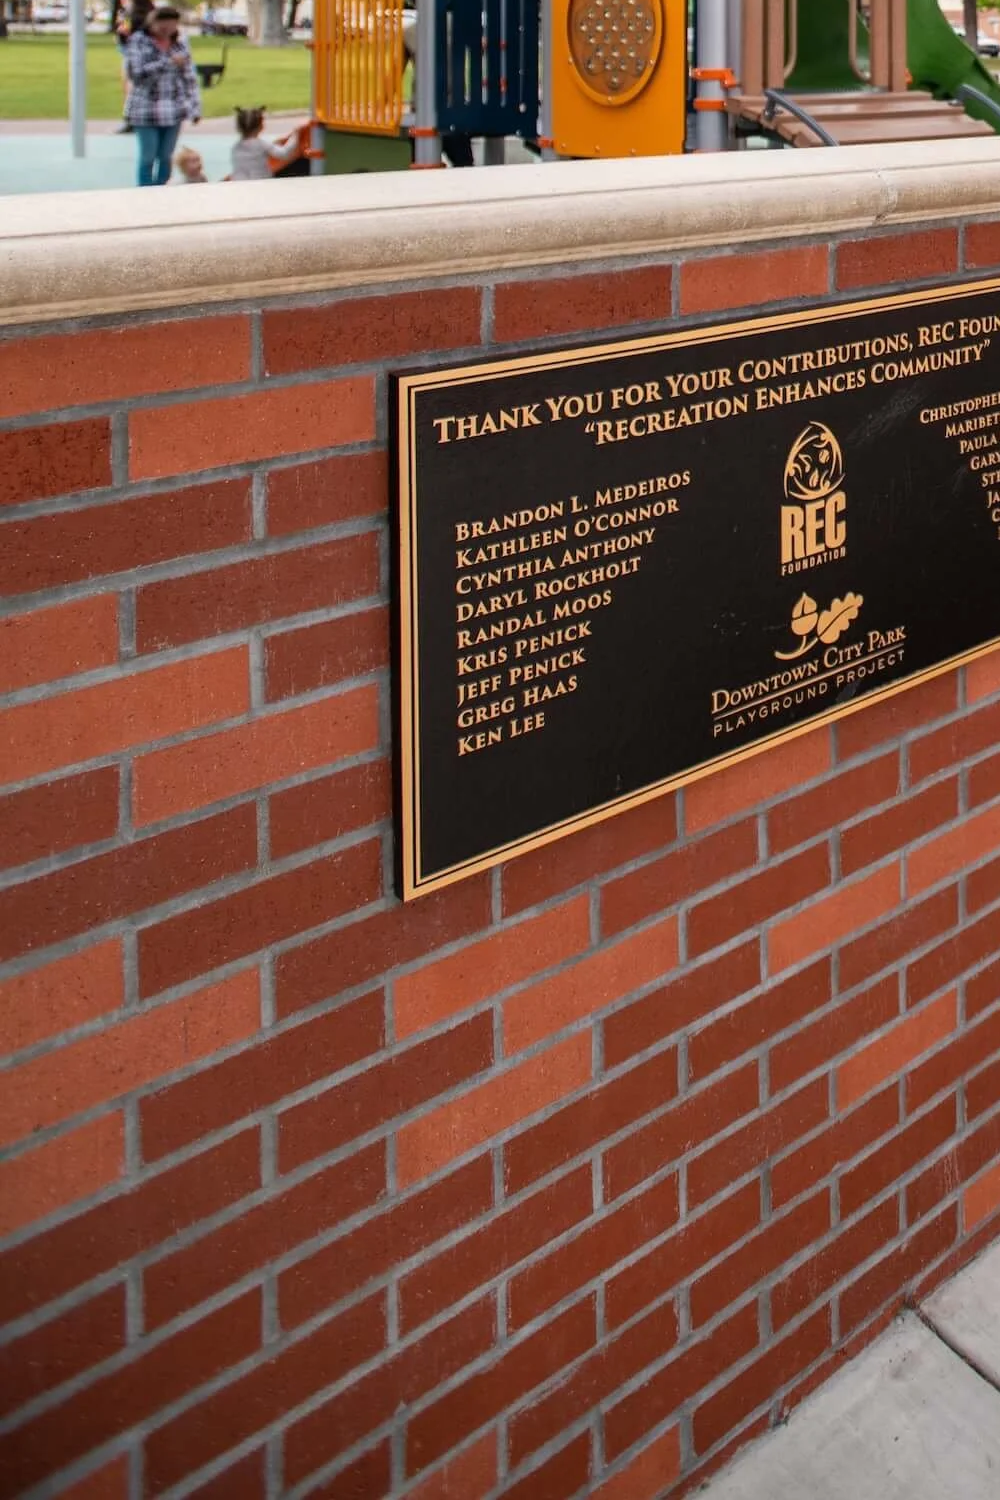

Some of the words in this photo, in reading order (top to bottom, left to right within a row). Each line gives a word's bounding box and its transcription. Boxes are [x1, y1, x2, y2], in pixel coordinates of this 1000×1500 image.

[432, 403, 542, 444] THANK
[544, 391, 604, 422] YOU
[610, 381, 663, 410] FOR
[665, 367, 734, 398] YOUR
[737, 332, 914, 383] CONTRIBUTIONS,
[917, 321, 955, 348] REC
[755, 368, 866, 410] ENHANCES
[959, 433, 998, 454] PAULA
[455, 501, 564, 542] BRANDON
[570, 495, 589, 514] L.
[594, 470, 691, 508] MEDEIROS
[780, 491, 847, 563] REC
[455, 525, 567, 569] KATHLEEN
[455, 556, 556, 595] CYNTHIA
[559, 527, 656, 568] ANTHONY
[781, 547, 846, 577] FOUNDATION
[456, 589, 528, 623] DARYL
[534, 556, 641, 601] ROCKHOLT
[457, 610, 547, 650] RANDAL
[552, 589, 612, 621] MOOS
[456, 646, 508, 676] KRIS
[515, 620, 592, 658] PENICK
[457, 674, 502, 707] JEFF
[509, 647, 586, 686] PENICK
[711, 659, 820, 714] DOWNTOWN
[822, 642, 866, 669] CITY
[866, 626, 907, 653] PARK
[457, 696, 515, 728] GREG
[523, 675, 578, 707] HAAS
[713, 683, 828, 738] PLAYGROUND
[836, 650, 905, 687] PROJECT
[458, 726, 502, 757] KEN
[510, 712, 545, 738] LEE
